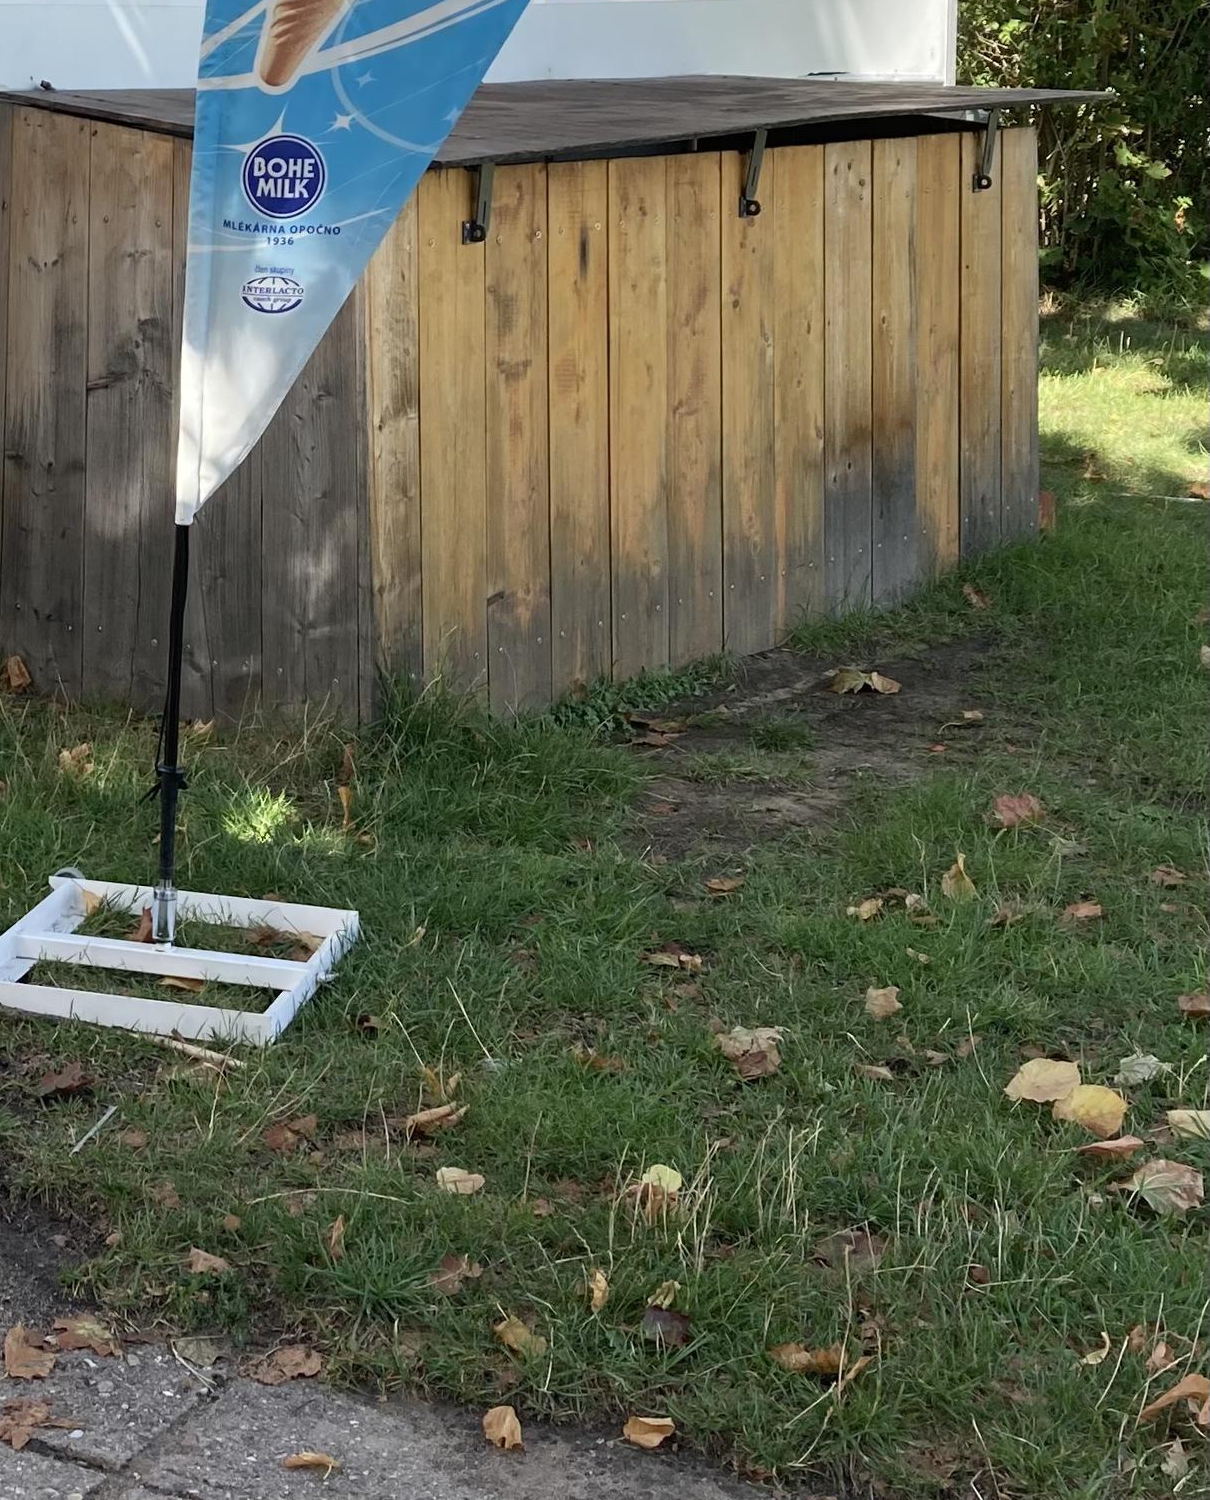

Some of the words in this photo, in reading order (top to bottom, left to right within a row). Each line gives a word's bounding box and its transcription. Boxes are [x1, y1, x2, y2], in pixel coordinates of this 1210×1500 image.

[253, 157, 315, 178] BOHE
[256, 178, 309, 199] MILK
[222, 219, 285, 235] MLÉKÁRNA
[289, 224, 341, 235] OPOČNO
[267, 236, 294, 246] 1936
[242, 285, 304, 295] INTERLACTO
